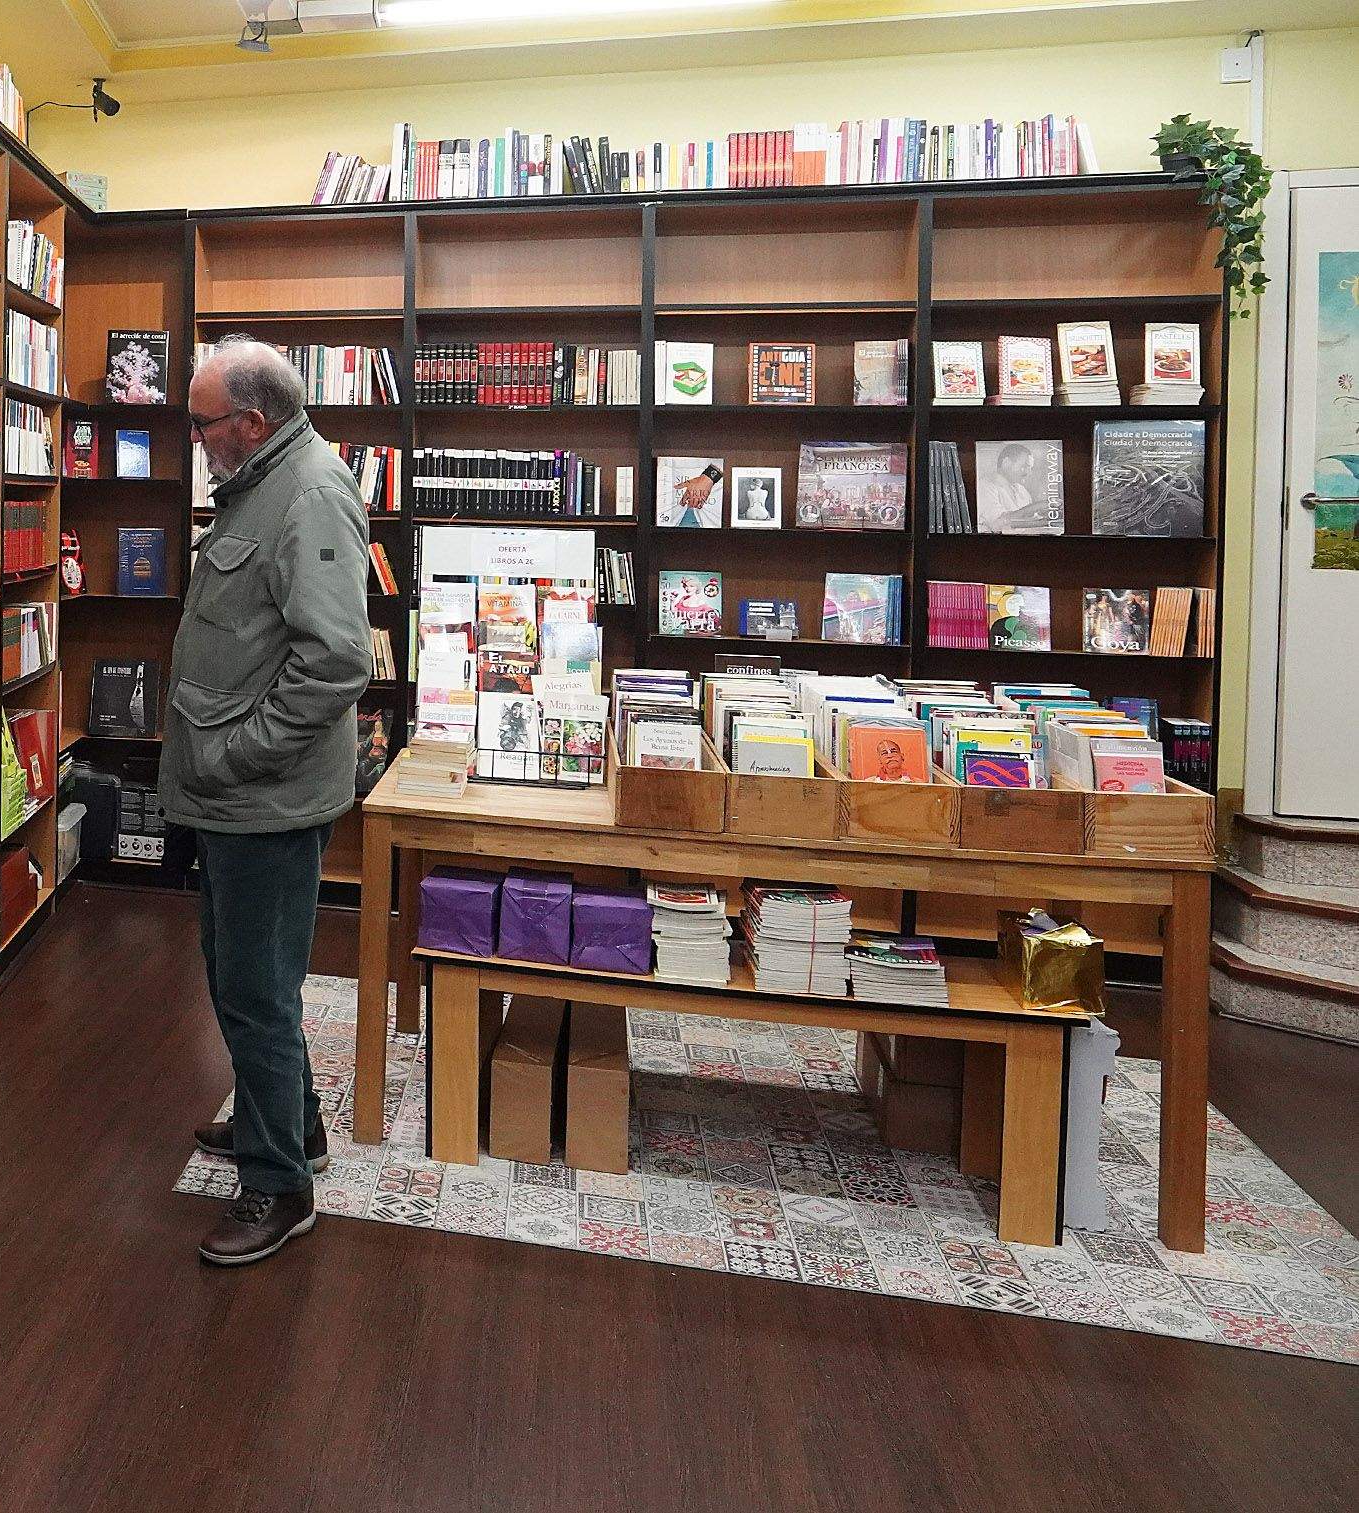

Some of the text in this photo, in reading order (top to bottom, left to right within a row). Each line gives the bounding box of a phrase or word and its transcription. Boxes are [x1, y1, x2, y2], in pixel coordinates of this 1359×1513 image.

[942, 355, 976, 364] PIZZA
[1104, 430, 1133, 438] Cidade
[1141, 430, 1193, 439] Democracia
[1141, 438, 1193, 447] Democracia
[823, 462, 889, 472] FRANCESA
[1044, 444, 1061, 530] hemingway
[498, 545, 527, 553] OFERTA
[490, 557, 517, 565] LIBROS
[994, 635, 1048, 648] Picasso
[1091, 636, 1141, 651] Goya
[488, 664, 531, 675] ATAJO
[726, 665, 772, 676] confines
[544, 681, 584, 691] Alegrías
[548, 699, 601, 713] Margaritas
[499, 752, 535, 763] Reagan
